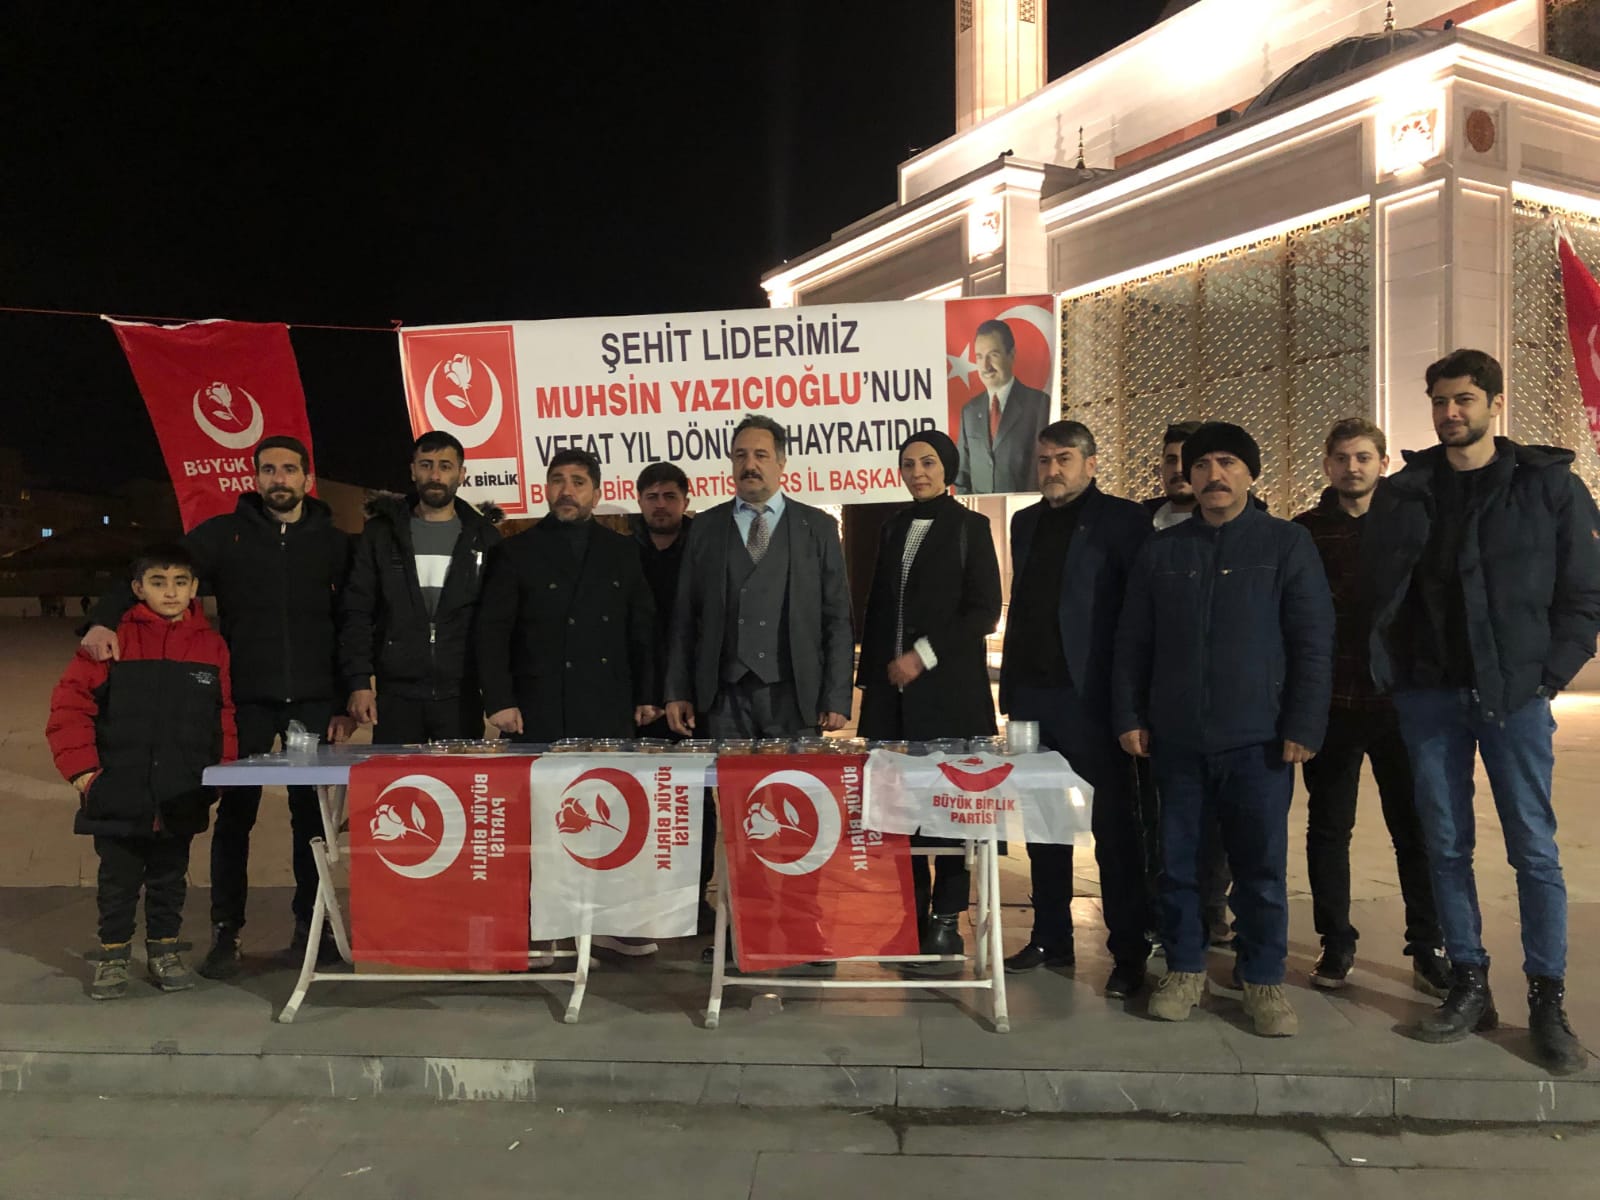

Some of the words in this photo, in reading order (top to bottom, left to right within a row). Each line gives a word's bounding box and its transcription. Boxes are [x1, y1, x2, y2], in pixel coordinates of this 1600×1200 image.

[601, 321, 692, 374] ŞEHİT
[702, 312, 860, 361] LİDERİMİZ
[535, 373, 662, 419] MUHSİN
[670, 364, 932, 412] YAZICIOĞLU'NUN
[620, 431, 661, 463] YIL
[667, 420, 737, 462] DÖNÜ
[183, 457, 249, 477] BÜYÜK
[475, 470, 518, 487] BİRLİK
[218, 475, 255, 492] PAR
[604, 475, 637, 501] BİR
[687, 471, 737, 497] ARTİS
[808, 466, 824, 492] İL
[933, 793, 973, 810] BÜYÜK
[975, 796, 1016, 811] BİRLİK
